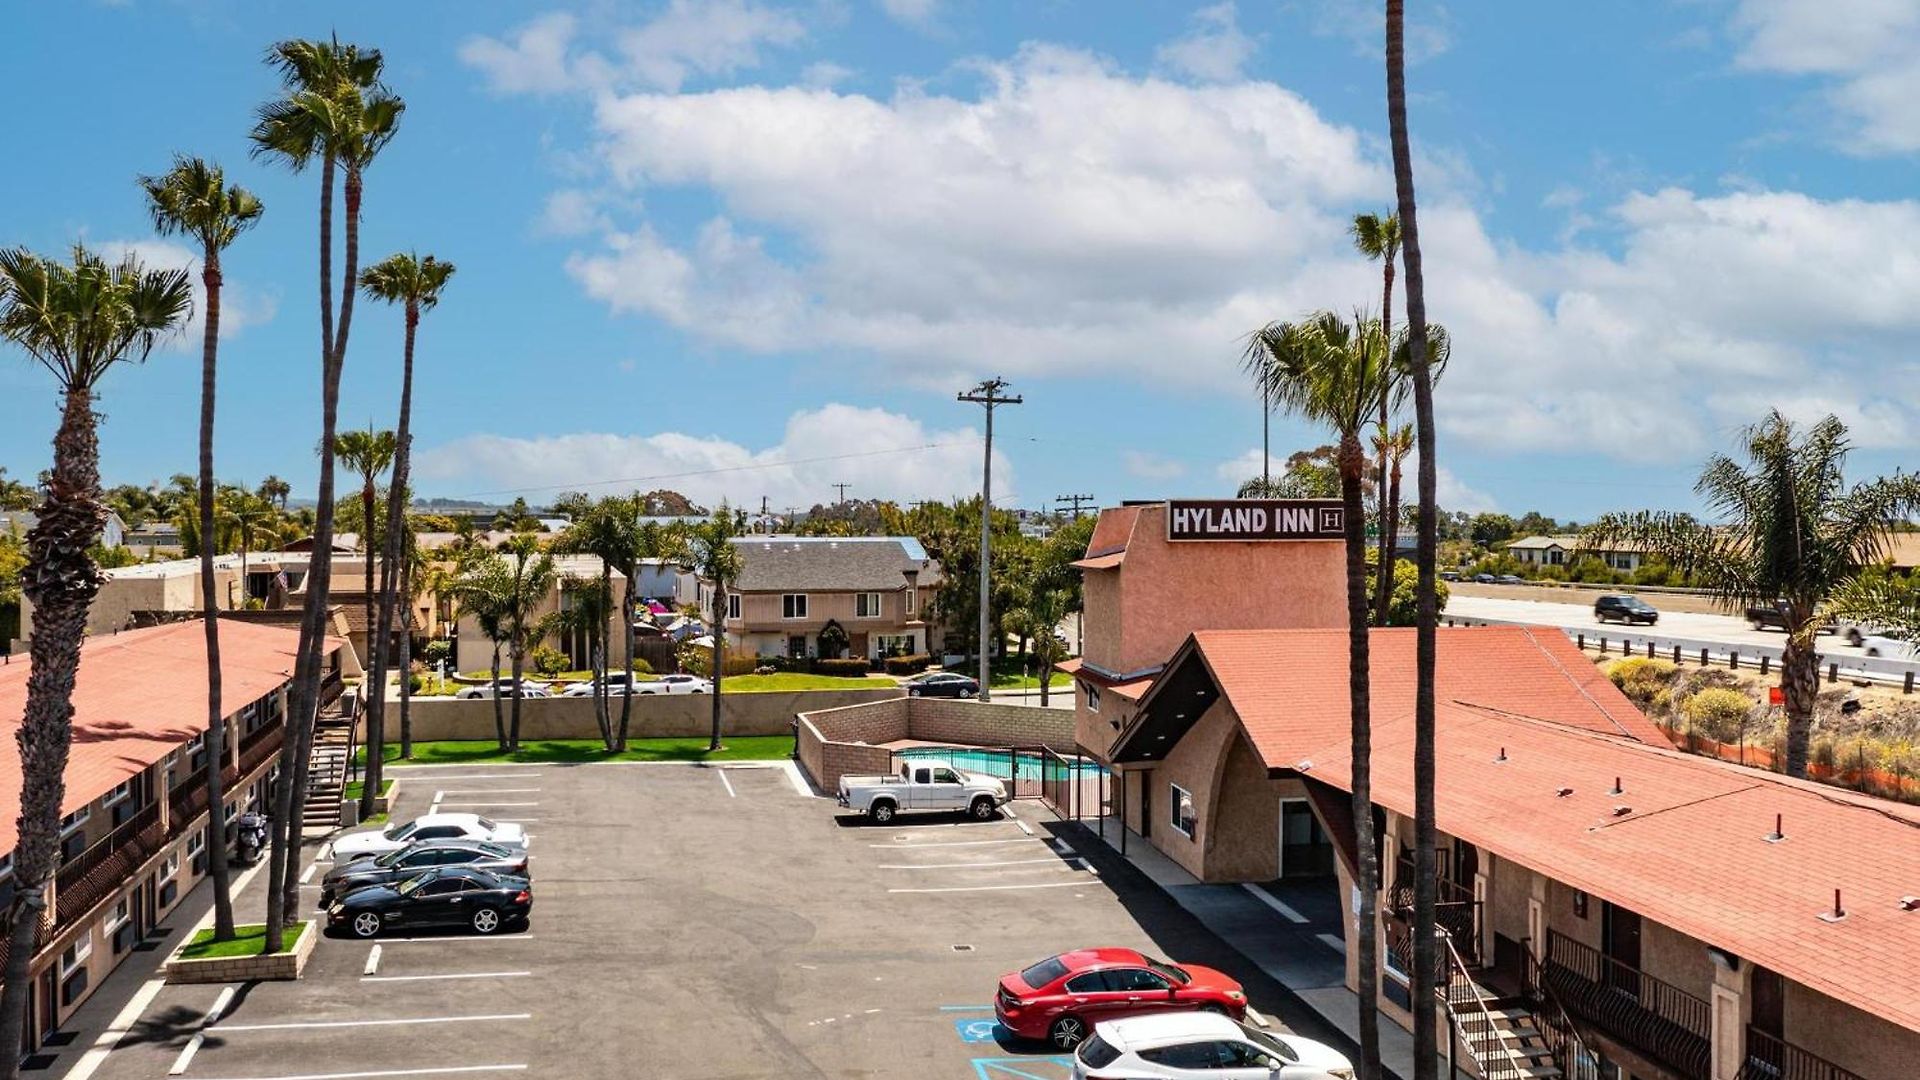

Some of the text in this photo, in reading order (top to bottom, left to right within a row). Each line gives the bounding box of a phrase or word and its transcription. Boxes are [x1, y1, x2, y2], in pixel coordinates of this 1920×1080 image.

[1173, 508, 1339, 533] HYLAND INN H
